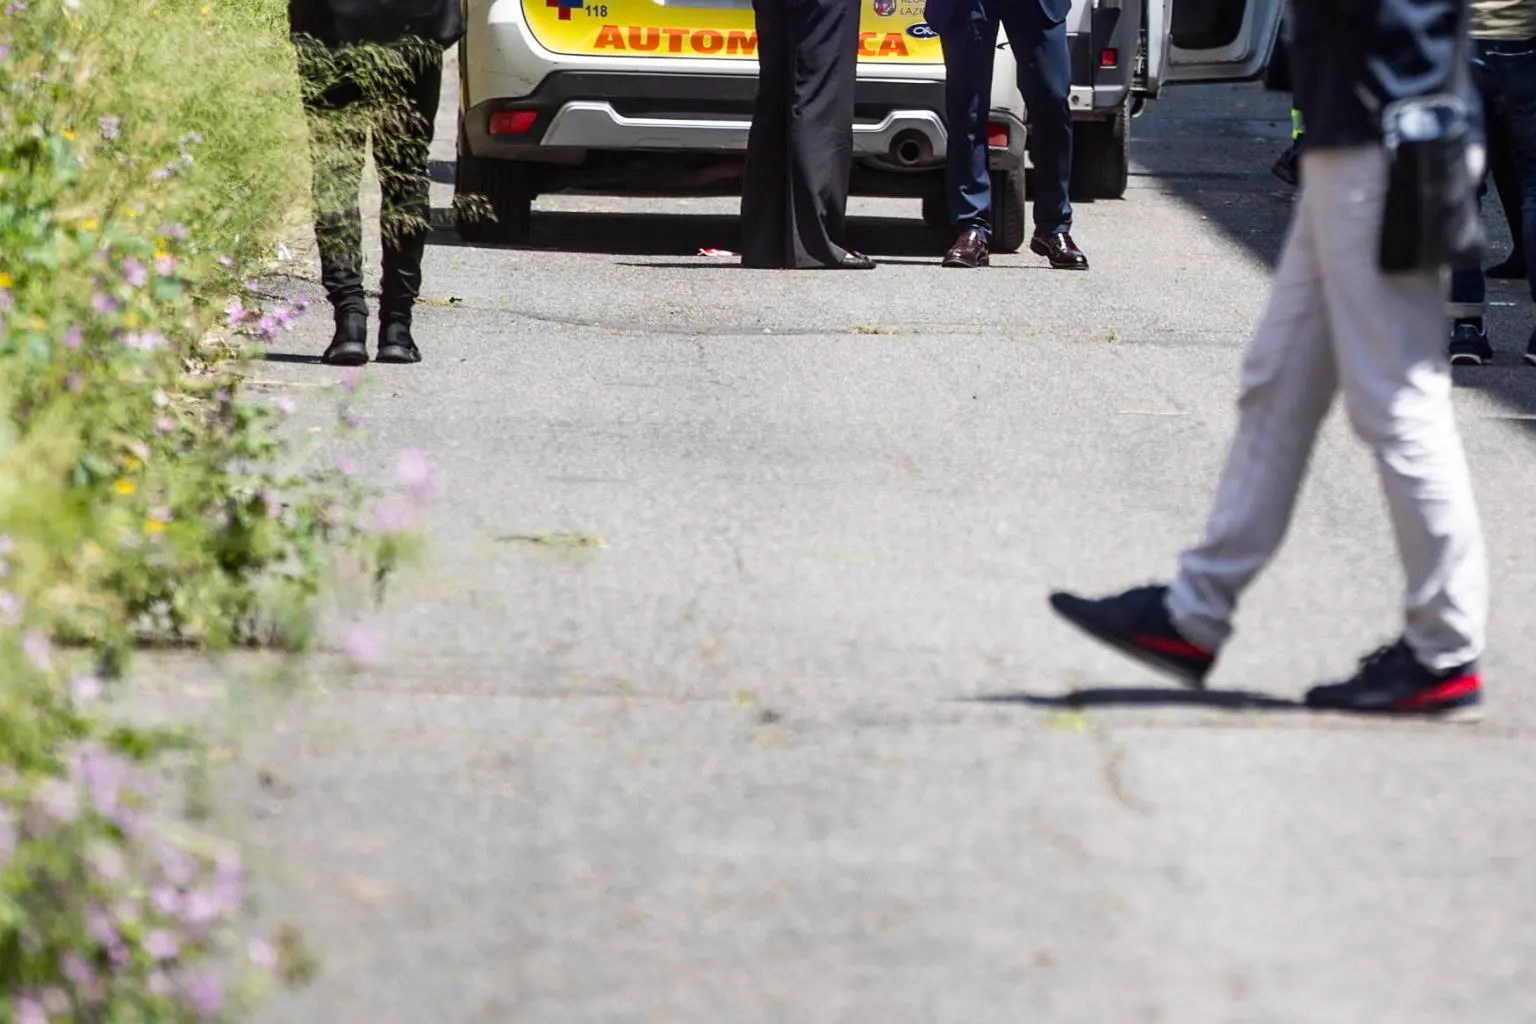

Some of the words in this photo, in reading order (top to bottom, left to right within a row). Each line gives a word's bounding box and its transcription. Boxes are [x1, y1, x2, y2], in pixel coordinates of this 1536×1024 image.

[585, 5, 608, 17] 118
[900, 7, 924, 16] LAZI
[594, 24, 909, 57] AUTOMCA
